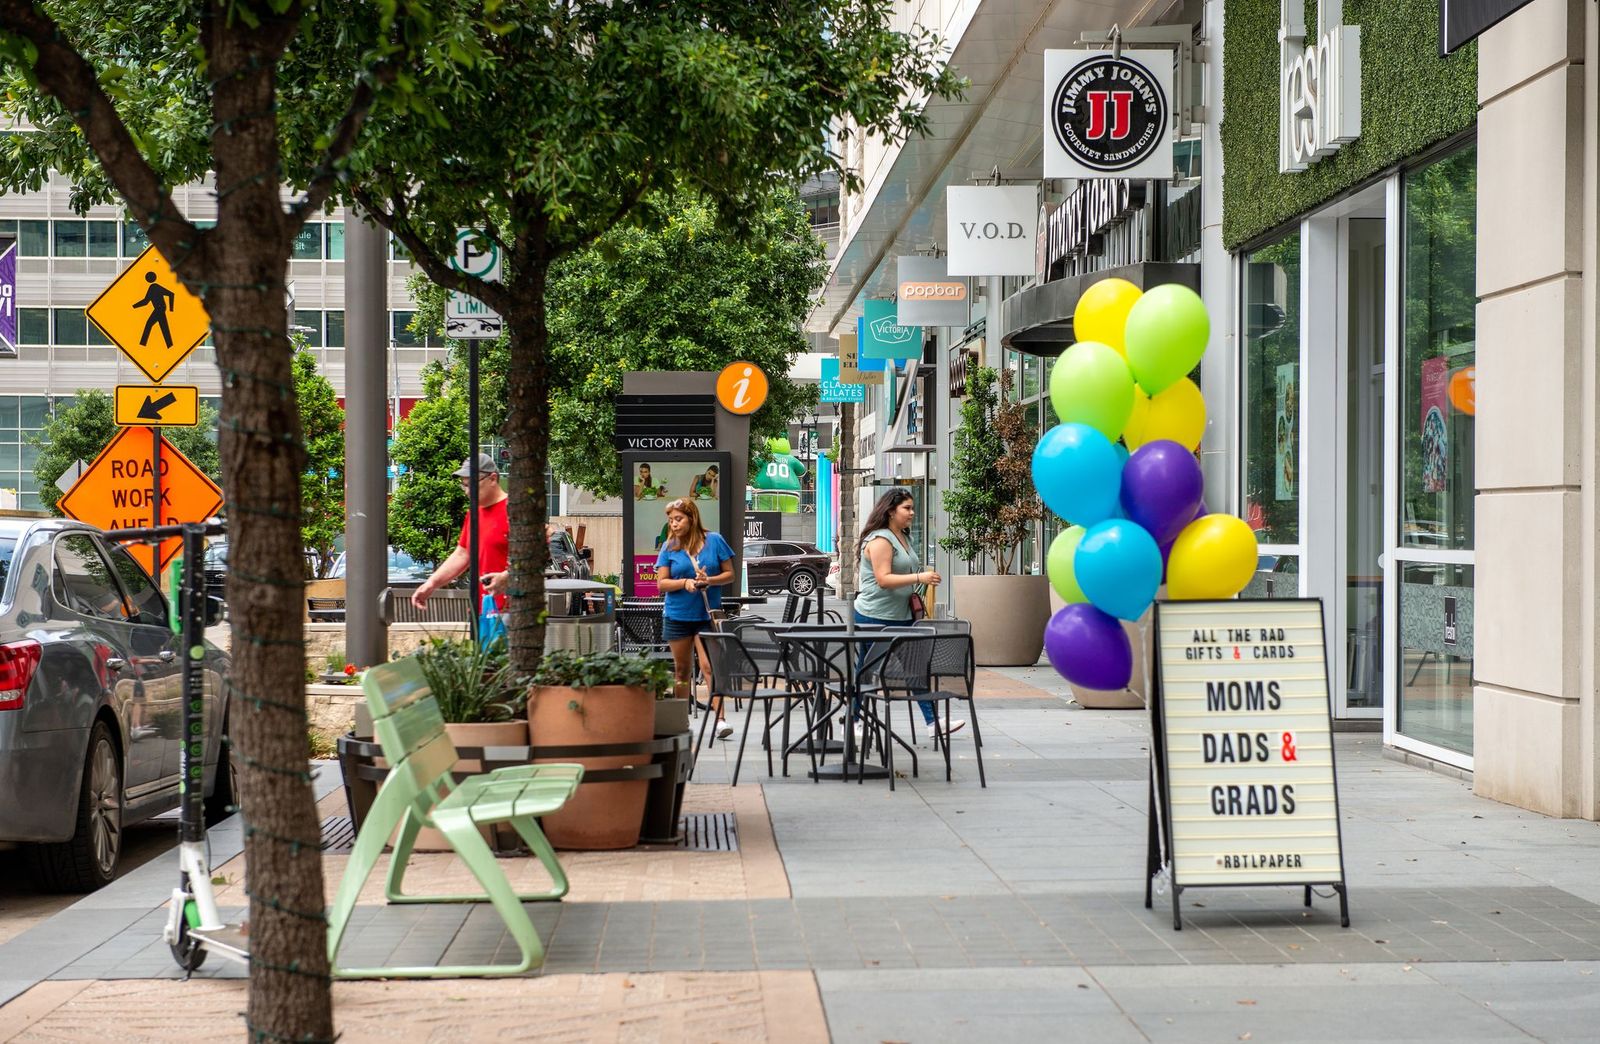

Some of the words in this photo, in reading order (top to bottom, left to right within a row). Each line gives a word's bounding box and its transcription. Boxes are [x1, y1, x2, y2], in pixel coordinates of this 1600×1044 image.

[1062, 66, 1105, 114] JIMMY
[1111, 66, 1157, 115] JOHN'S
[1087, 91, 1133, 140] JJ
[1064, 122, 1101, 160] GOURMET
[1104, 122, 1155, 161] SANDWICHES
[1085, 179, 1130, 257] JOHNS
[960, 222, 1027, 240] V.O.D.
[905, 284, 963, 298] popbar
[823, 389, 862, 397] PILATES
[628, 438, 679, 448] VICTORY
[683, 438, 713, 448] PARK
[112, 458, 169, 478] ROAD
[766, 462, 789, 478] 00
[112, 488, 172, 508] WORK
[110, 517, 179, 530] AHED
[747, 521, 763, 536] JUST
[1193, 629, 1217, 642] ALL
[1227, 628, 1251, 642] THE
[1260, 628, 1285, 641] RAD
[1186, 646, 1222, 660] GIFTS
[1233, 645, 1241, 660] &
[1253, 645, 1294, 659] CARDS
[1206, 680, 1281, 711] MOMS
[1202, 732, 1269, 763] DADS
[1281, 731, 1297, 762] &
[1211, 784, 1295, 815] GRADS
